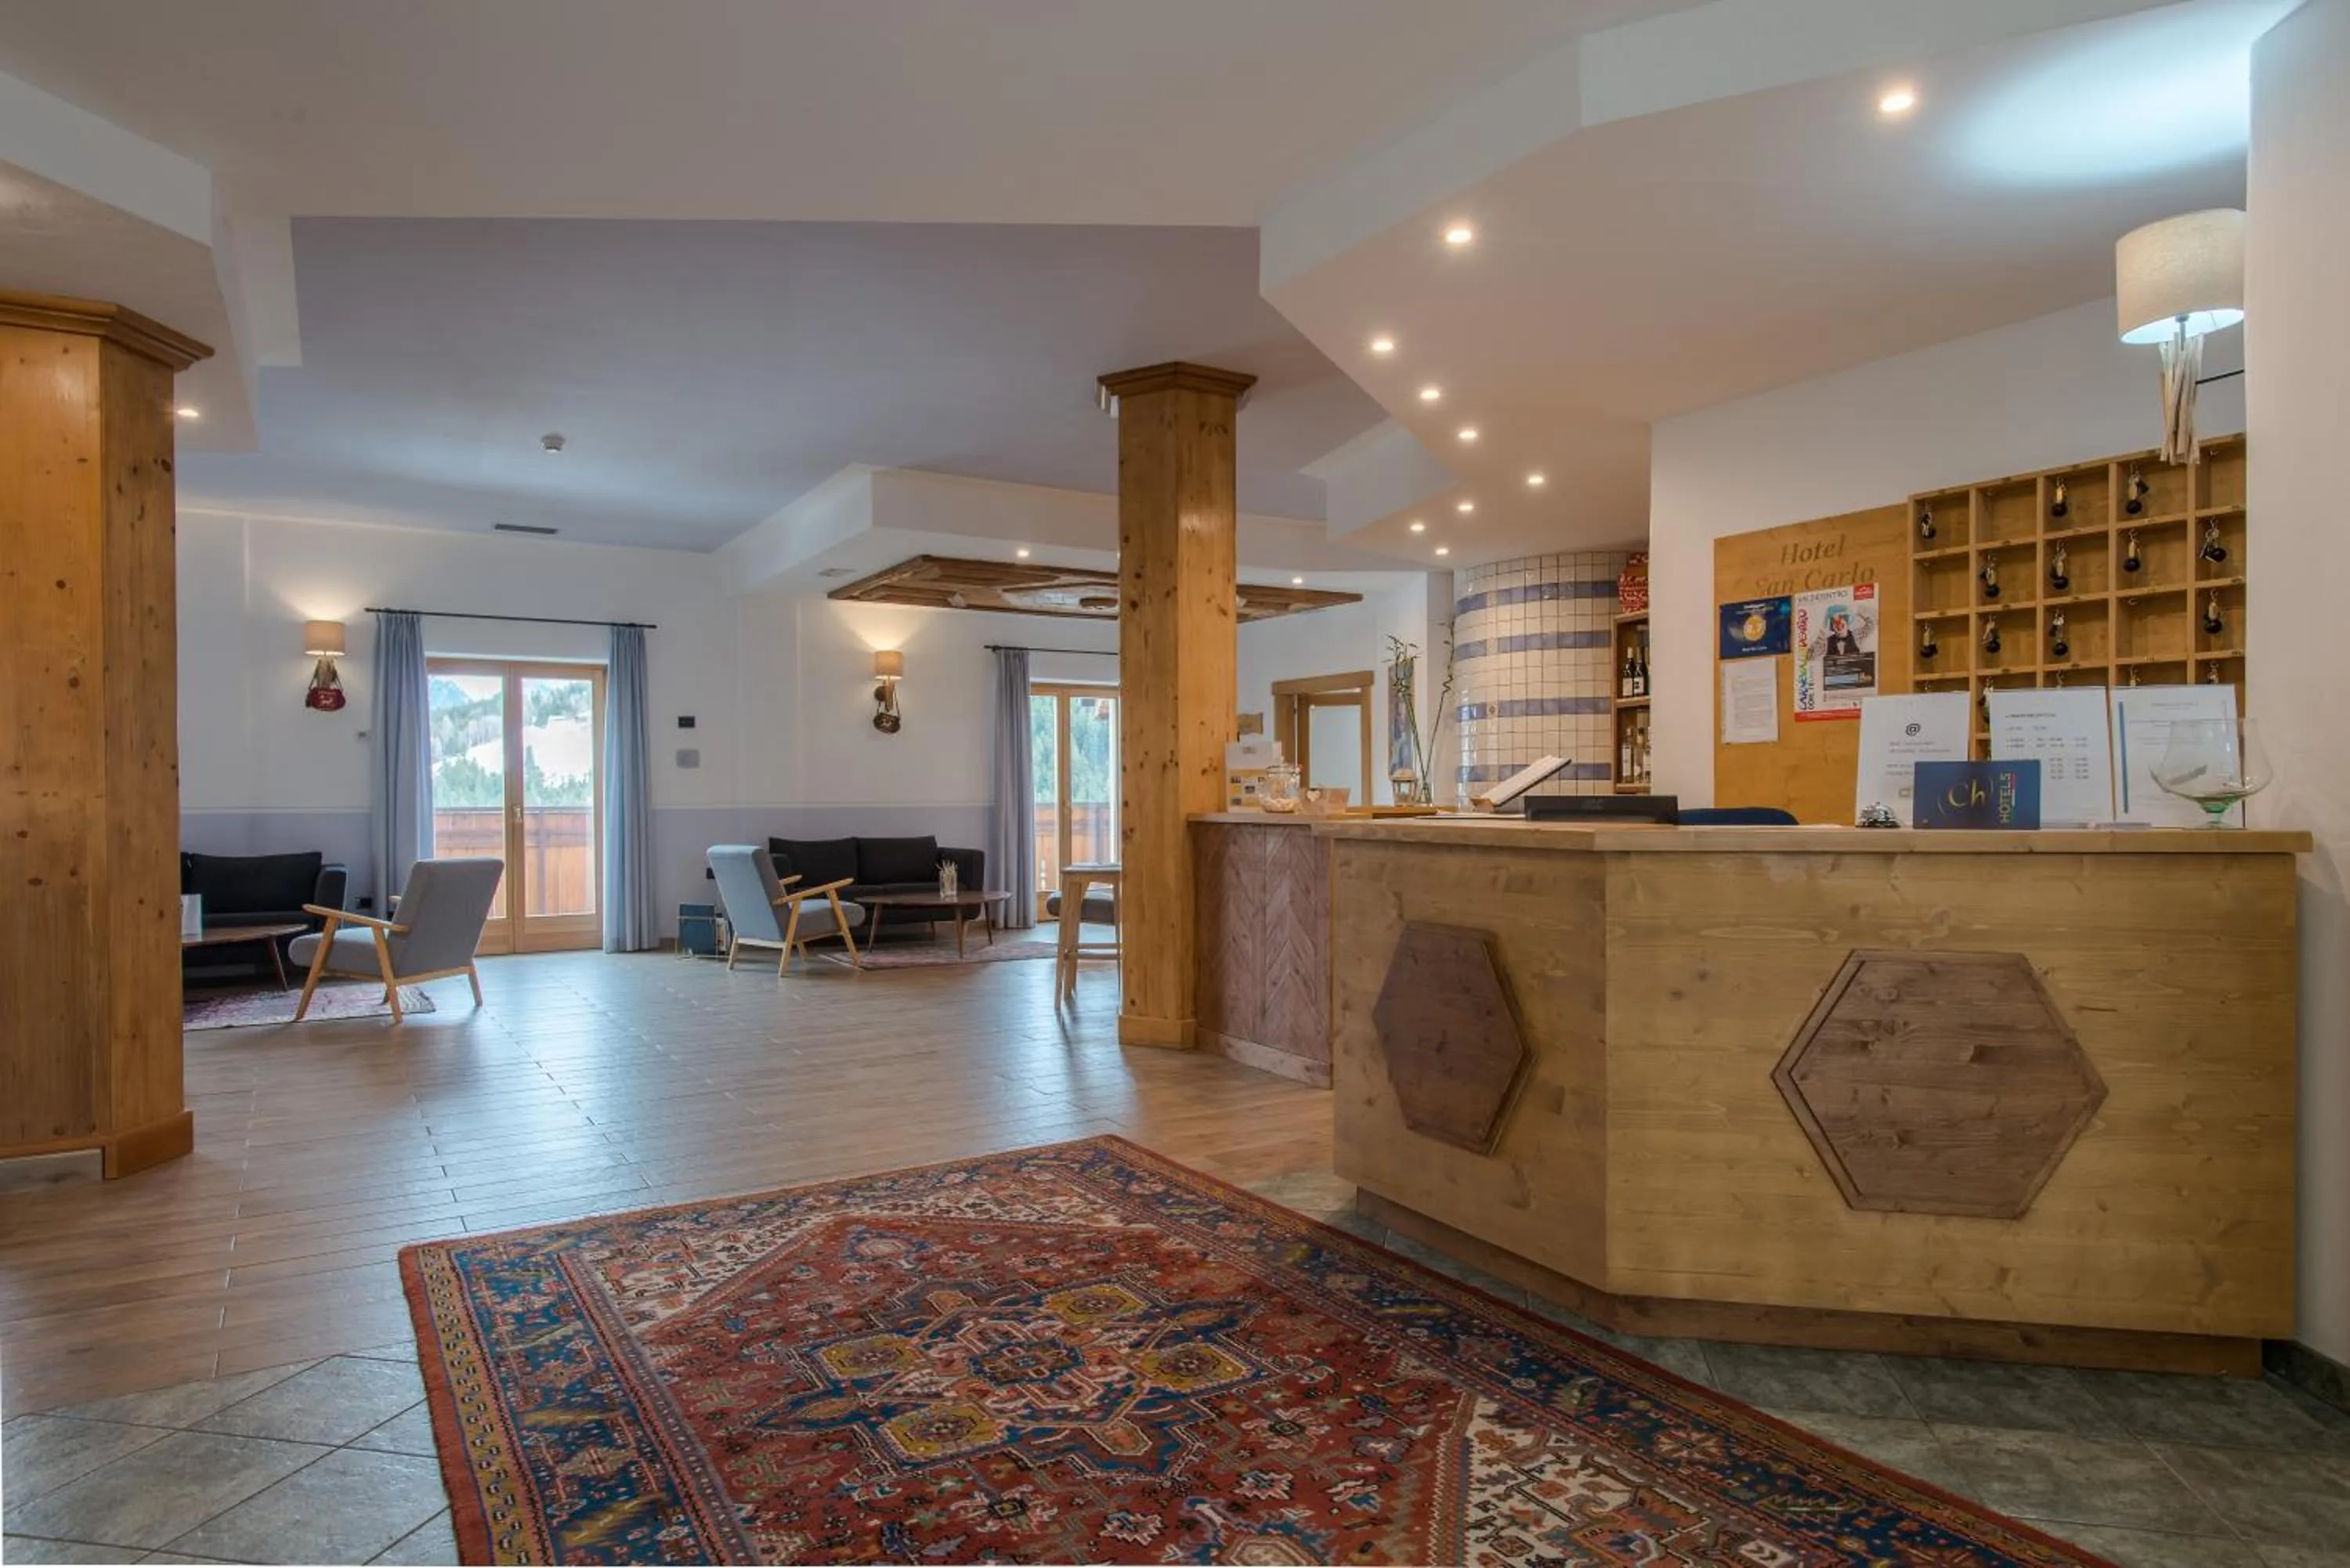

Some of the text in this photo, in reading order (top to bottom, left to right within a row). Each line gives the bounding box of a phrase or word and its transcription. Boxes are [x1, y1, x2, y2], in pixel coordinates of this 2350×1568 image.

[1781, 534, 1845, 565] Hotel
[1755, 562, 1875, 596] San Carlo
[1948, 779, 1986, 808] Ch
[1999, 772, 2011, 823] HOTELS
